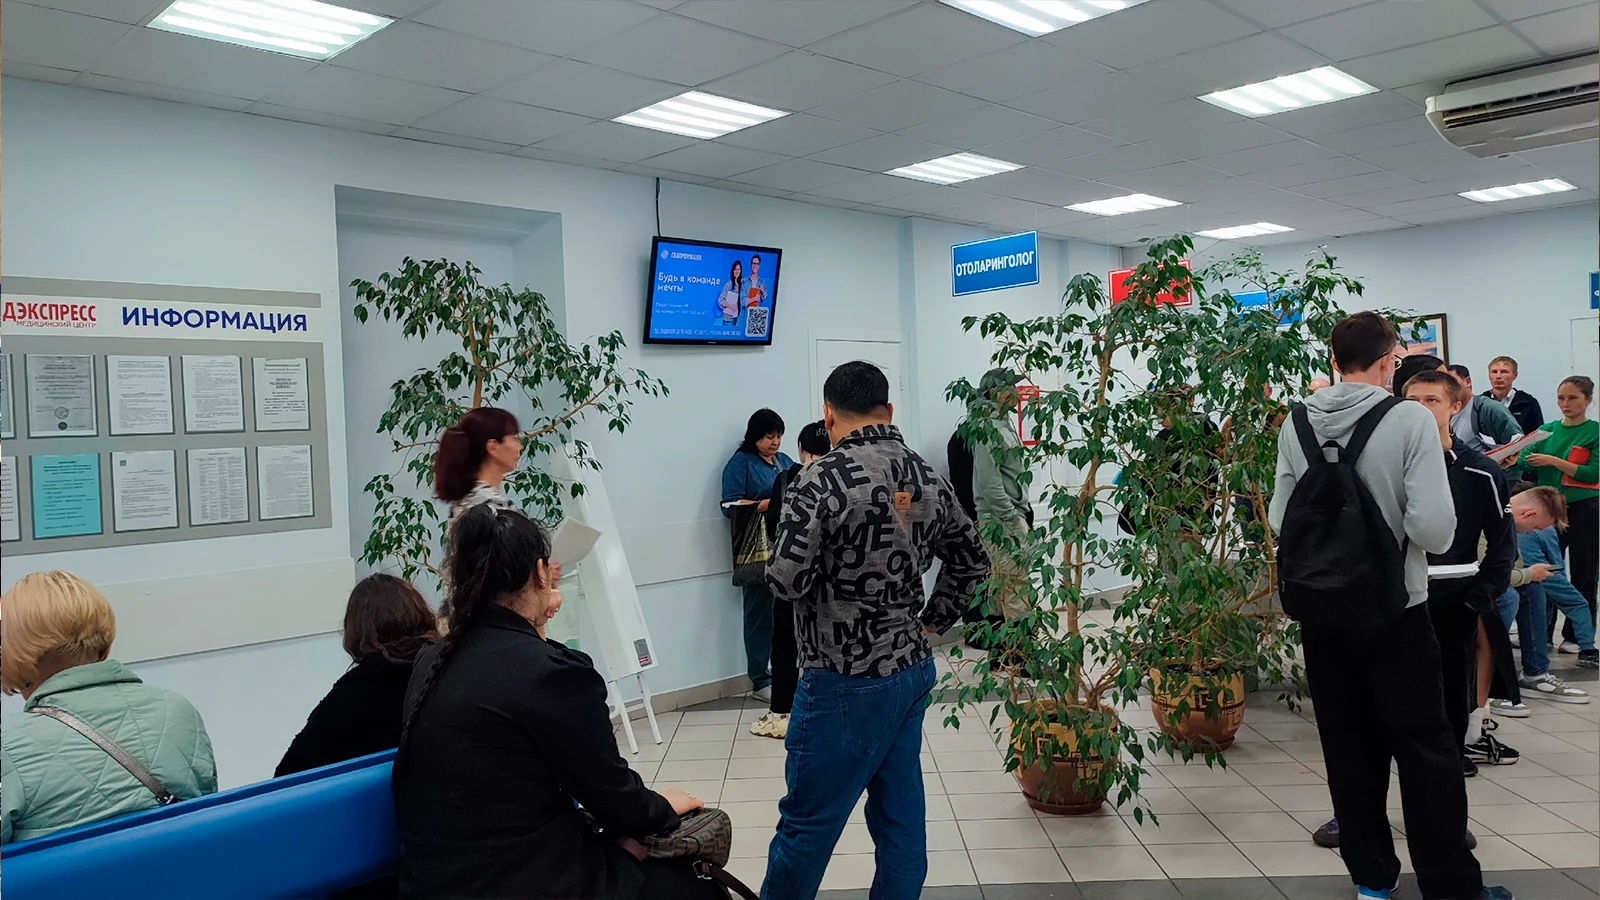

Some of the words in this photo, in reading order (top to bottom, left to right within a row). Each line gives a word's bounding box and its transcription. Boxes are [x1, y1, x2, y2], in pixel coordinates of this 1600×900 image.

[955, 250, 1035, 277] ОТОЛАРИНГОЛОГ
[658, 272, 678, 283] Будь
[680, 275, 685, 283] в
[687, 276, 721, 286] команде
[657, 284, 684, 292] мечты
[2, 301, 97, 322] ДЭКСПРЕСС
[121, 306, 308, 333] ИНФОРМАЦИЯ
[16, 320, 72, 328] МЕДИЦИНСКИЙ
[73, 321, 96, 329] ЦЕНТР
